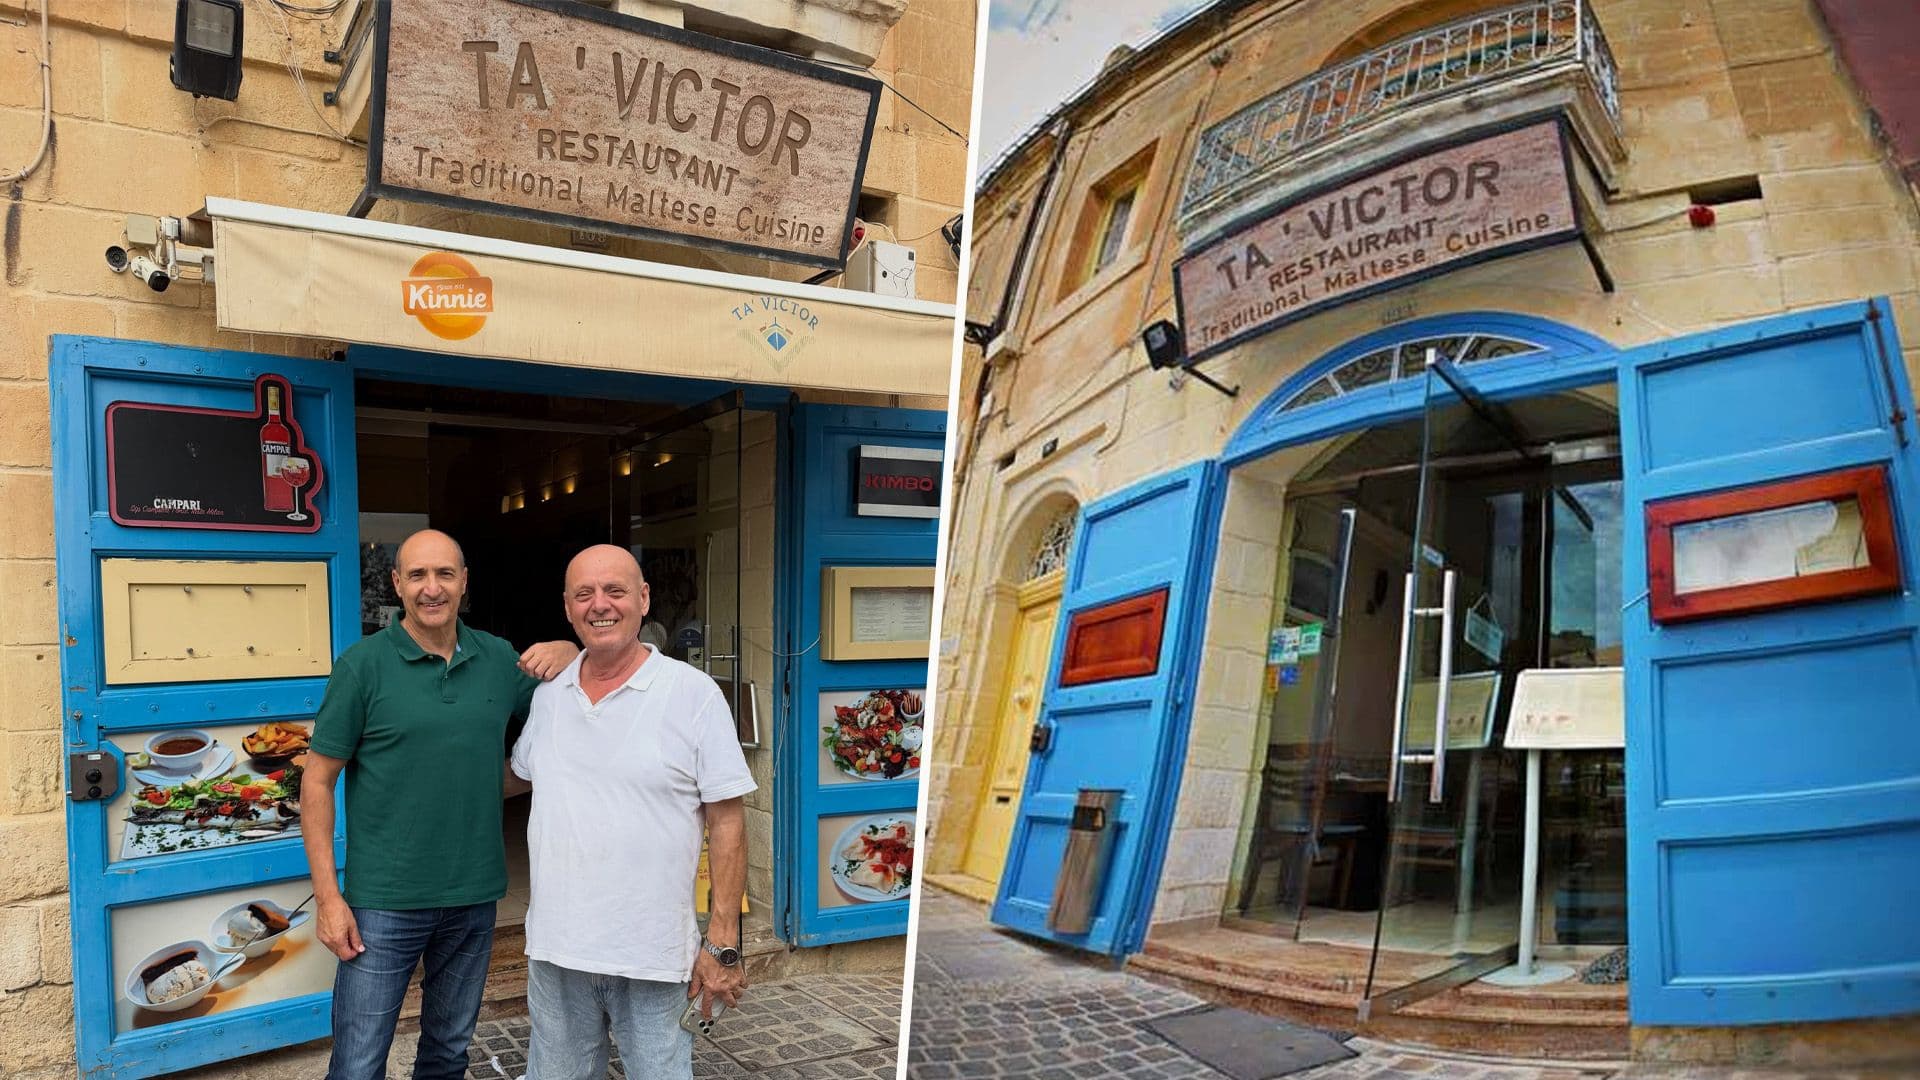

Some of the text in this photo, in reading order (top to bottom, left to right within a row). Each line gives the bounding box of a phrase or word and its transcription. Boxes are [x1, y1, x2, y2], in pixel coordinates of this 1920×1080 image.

[613, 51, 812, 177] VICTOR
[412, 146, 826, 244] Traditional Maltese Cuisine
[537, 128, 740, 197] RESTAURANT
[1308, 160, 1501, 241] VICTOR
[1200, 210, 1551, 344] Traditional Maltese Cuisine
[1267, 218, 1440, 293] RESTAURANT
[409, 284, 487, 309] Kinnie
[761, 297, 818, 331] VICTOR
[153, 498, 201, 510] CAMPARI
[865, 473, 934, 492] KIMBO
